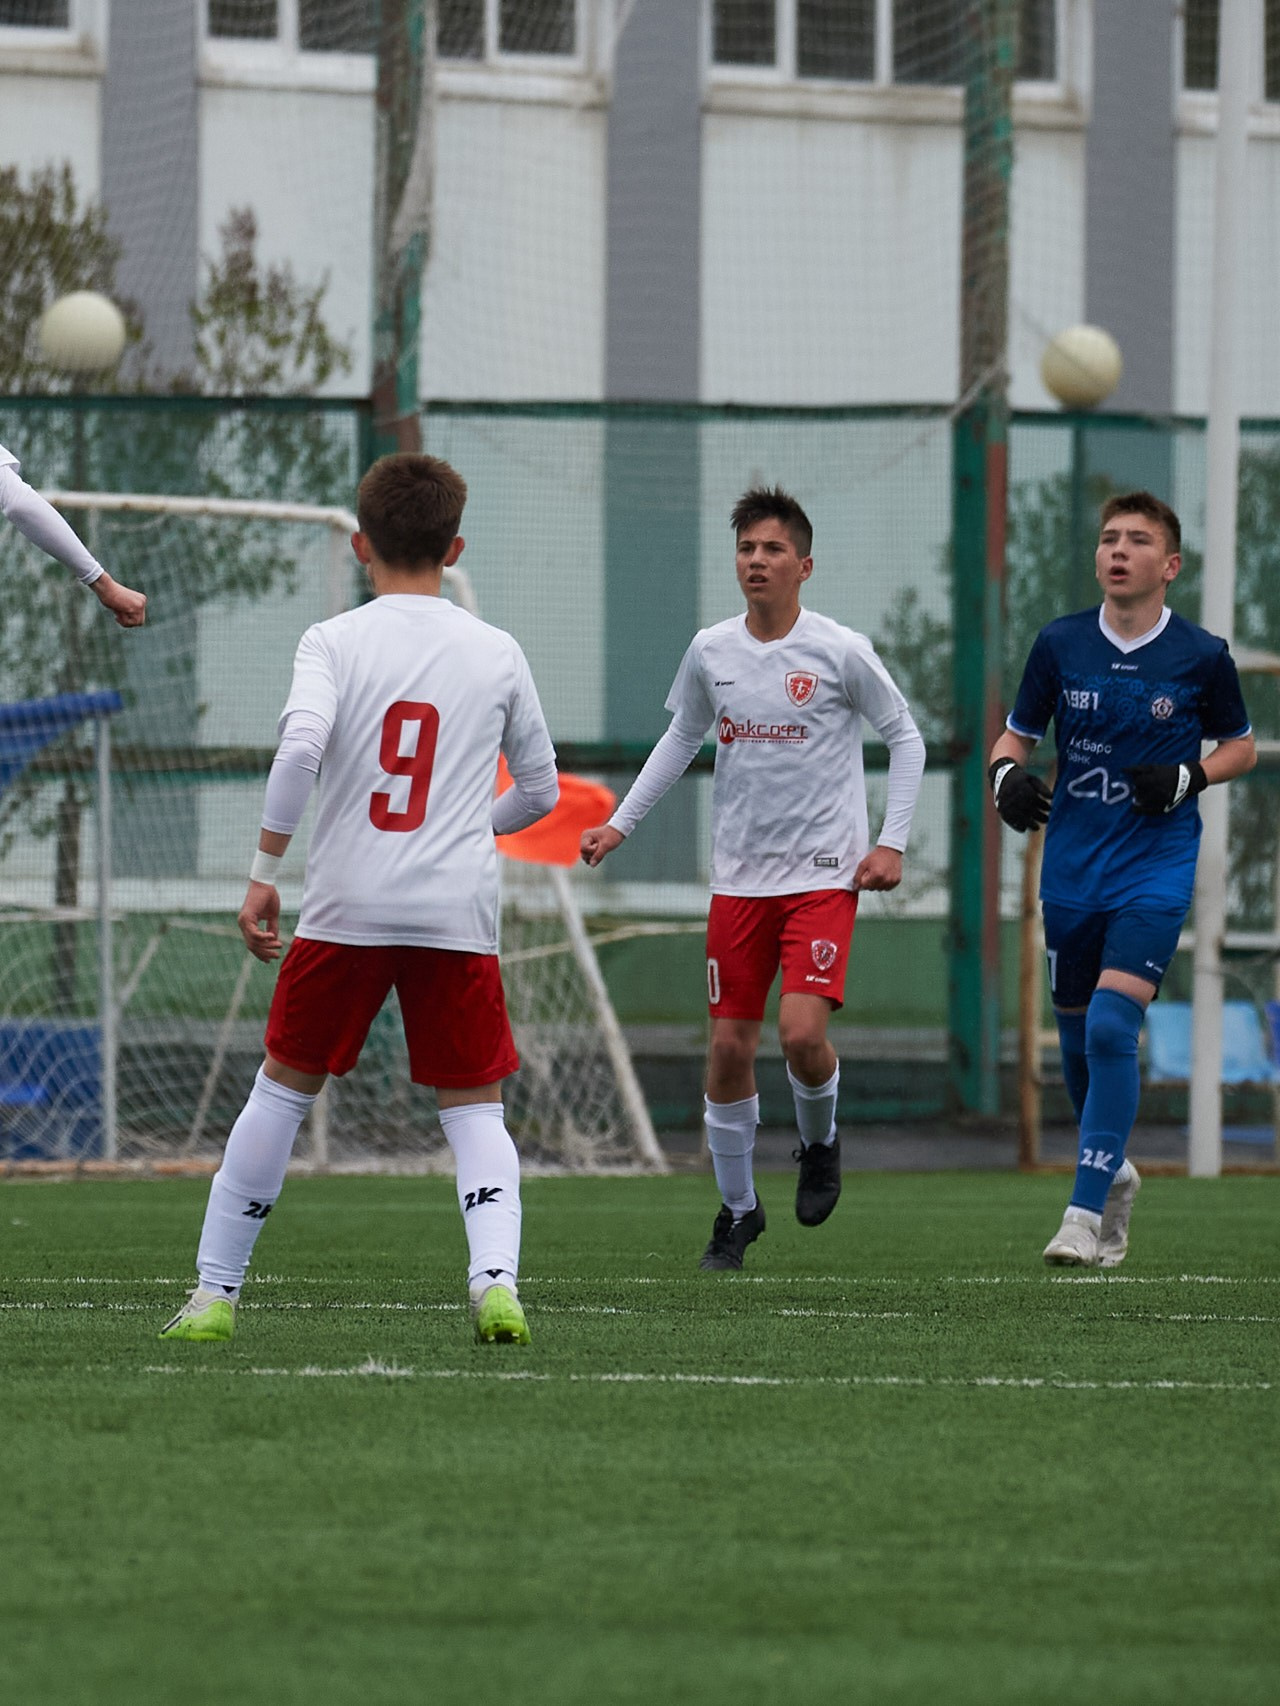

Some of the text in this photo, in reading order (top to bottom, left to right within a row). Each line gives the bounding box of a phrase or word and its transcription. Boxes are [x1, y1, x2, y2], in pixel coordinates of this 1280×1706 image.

[1063, 689, 1099, 711] 1981
[369, 700, 439, 832] 9
[707, 957, 721, 1004] 0
[1080, 1148, 1114, 1173] 2K
[464, 1187, 503, 1212] 2K
